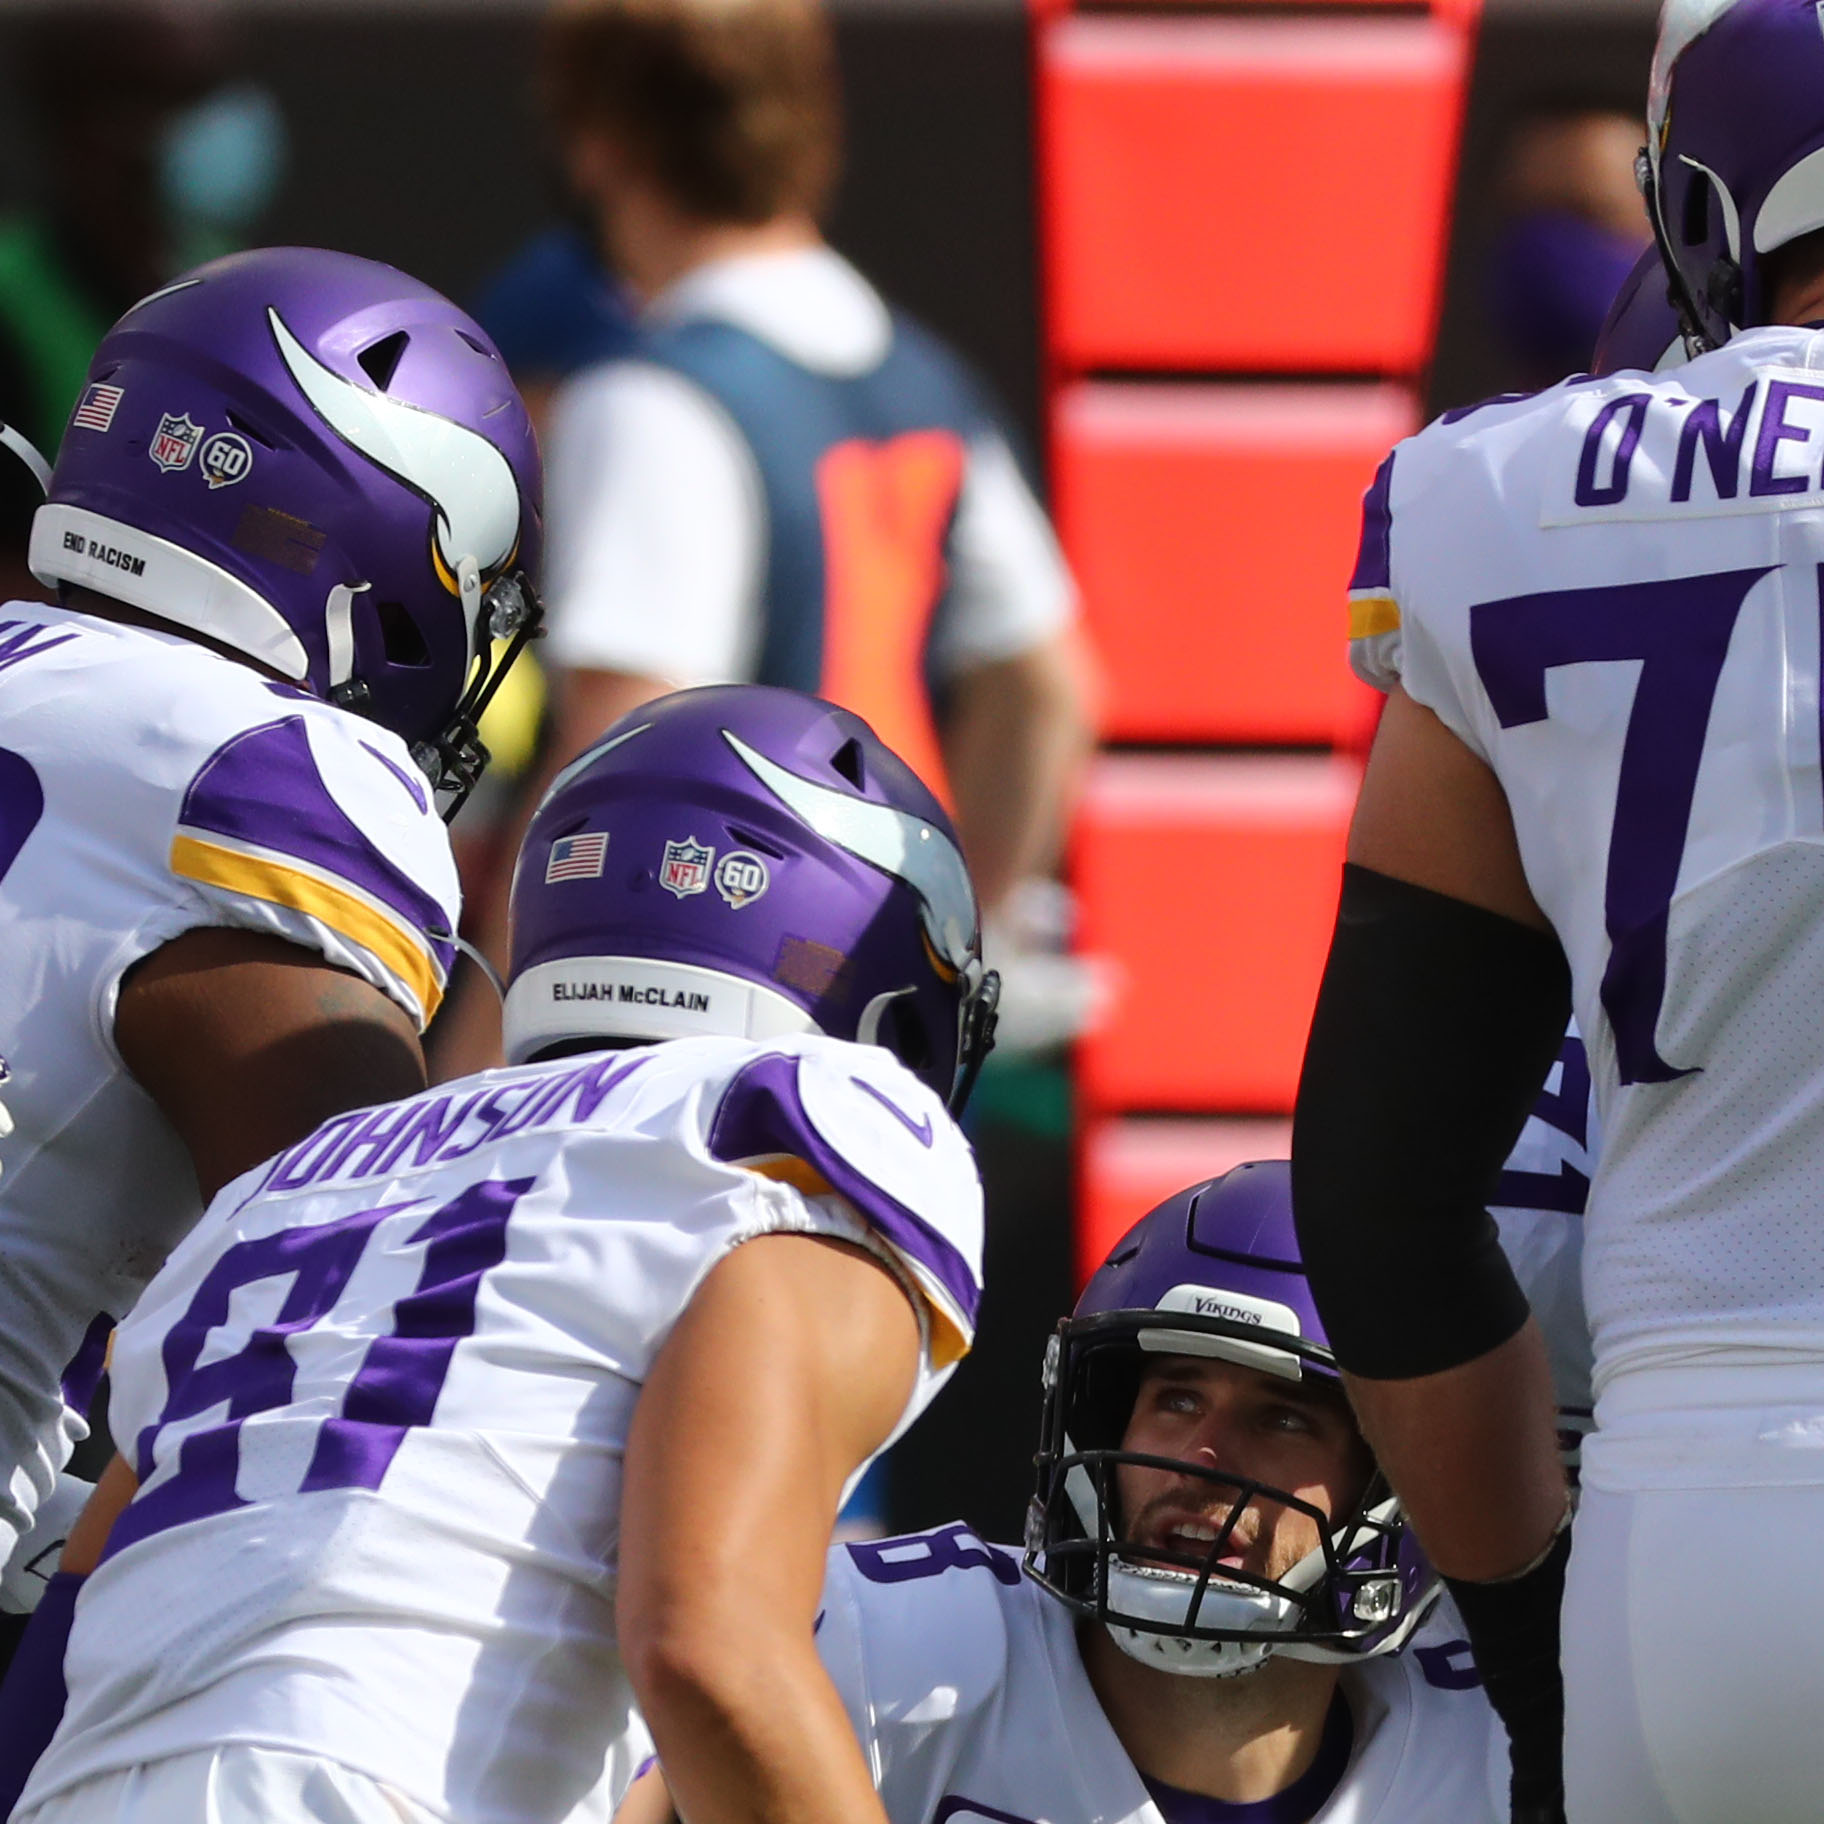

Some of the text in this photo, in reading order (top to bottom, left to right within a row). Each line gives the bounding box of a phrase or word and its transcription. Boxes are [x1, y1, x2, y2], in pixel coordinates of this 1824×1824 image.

[156, 434, 186, 464] NFL
[206, 440, 246, 476] 60
[63, 531, 147, 577] END RACISM
[667, 863, 702, 888] NFL
[724, 860, 761, 892] 60
[552, 983, 710, 1013] ELIJAH McCLAIN
[226, 1054, 659, 1222] JOHNSON
[97, 1175, 538, 1568] 81
